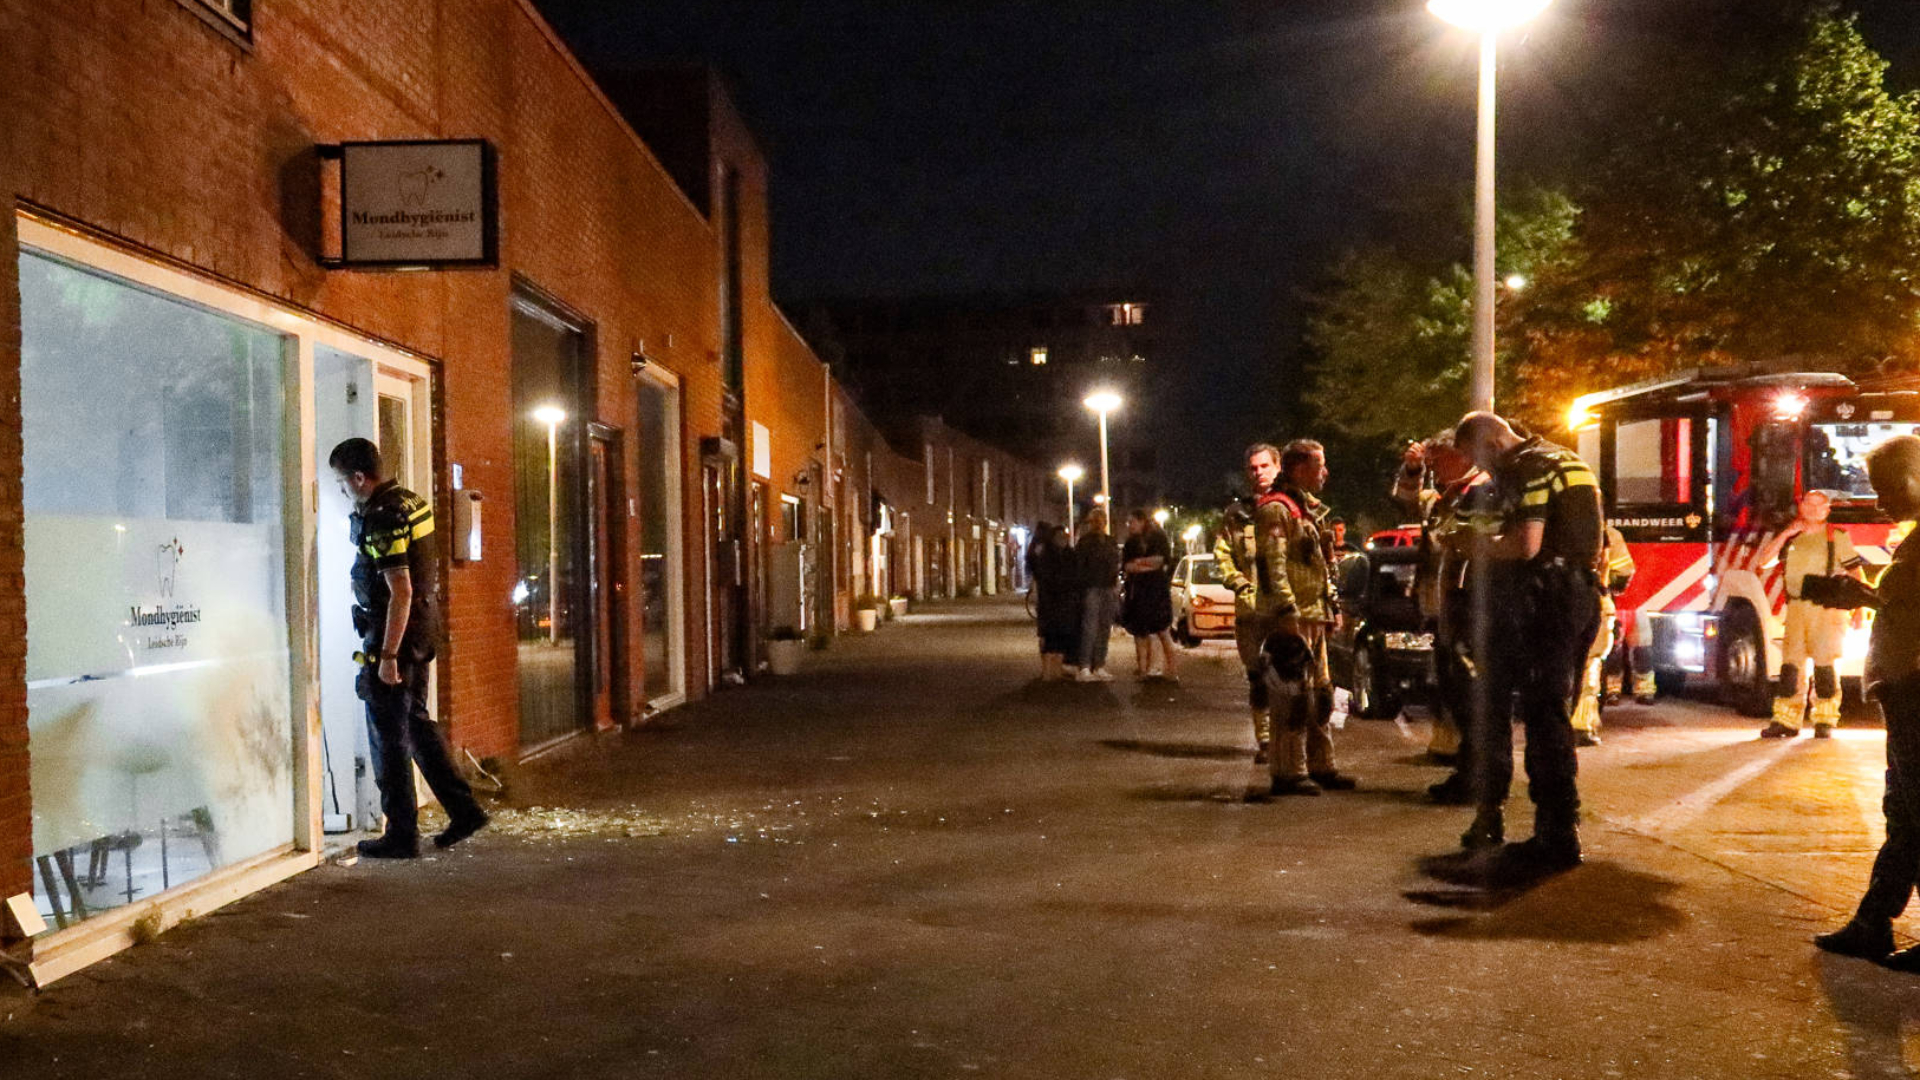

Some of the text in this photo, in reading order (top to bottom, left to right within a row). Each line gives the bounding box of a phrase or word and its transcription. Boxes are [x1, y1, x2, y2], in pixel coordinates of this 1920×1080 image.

[352, 209, 475, 227] Mondhygiënist
[1607, 518, 1684, 527] BRANDWEER
[130, 605, 201, 630] Mondhygiënist
[148, 636, 174, 649] Leidsche
